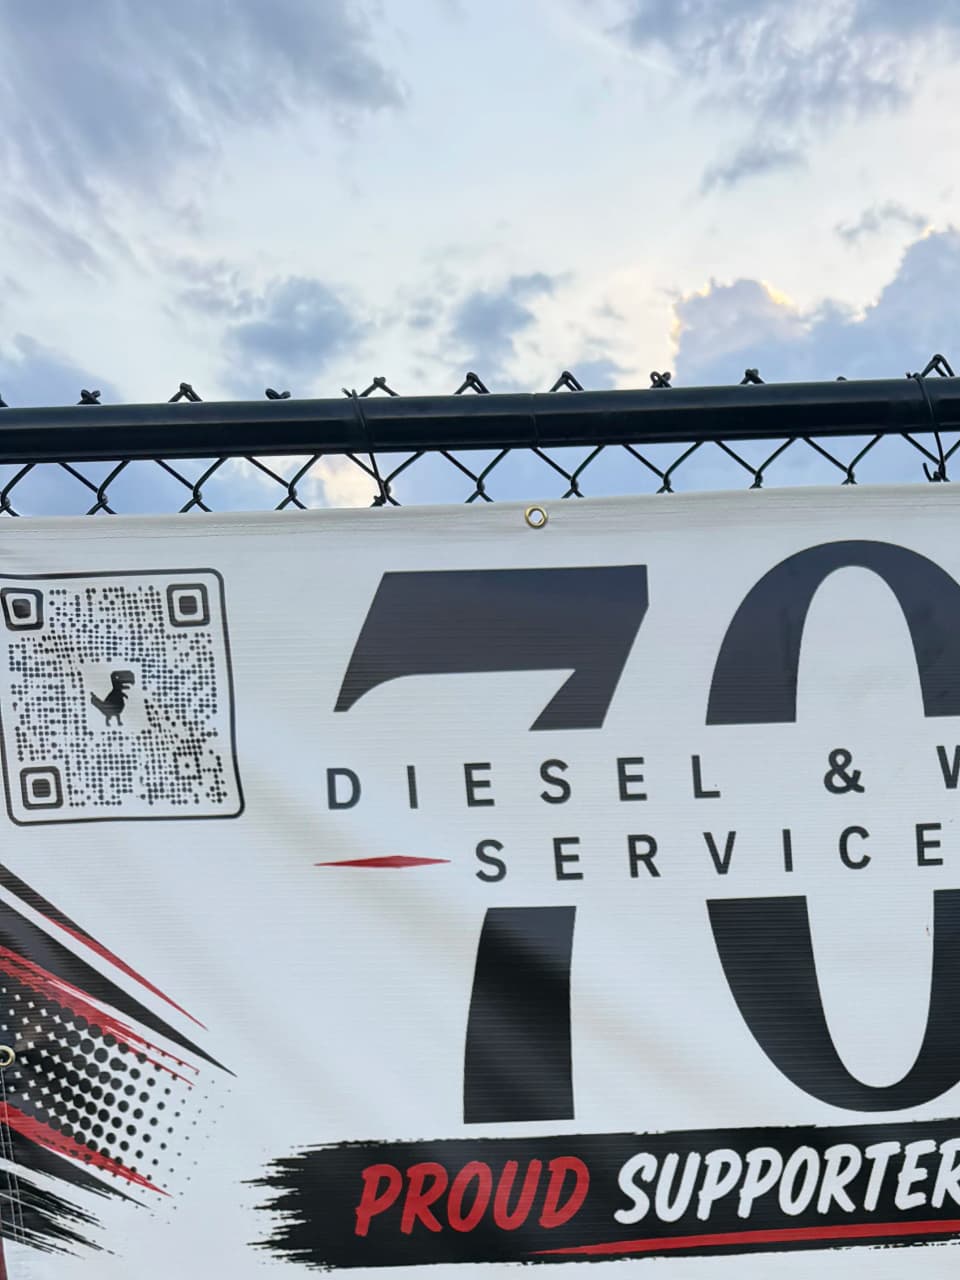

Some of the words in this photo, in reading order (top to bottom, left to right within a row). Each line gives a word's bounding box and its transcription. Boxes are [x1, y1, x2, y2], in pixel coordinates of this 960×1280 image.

[327, 754, 721, 810] DIESEL
[823, 748, 865, 793] &
[354, 1155, 590, 1237] PROUD
